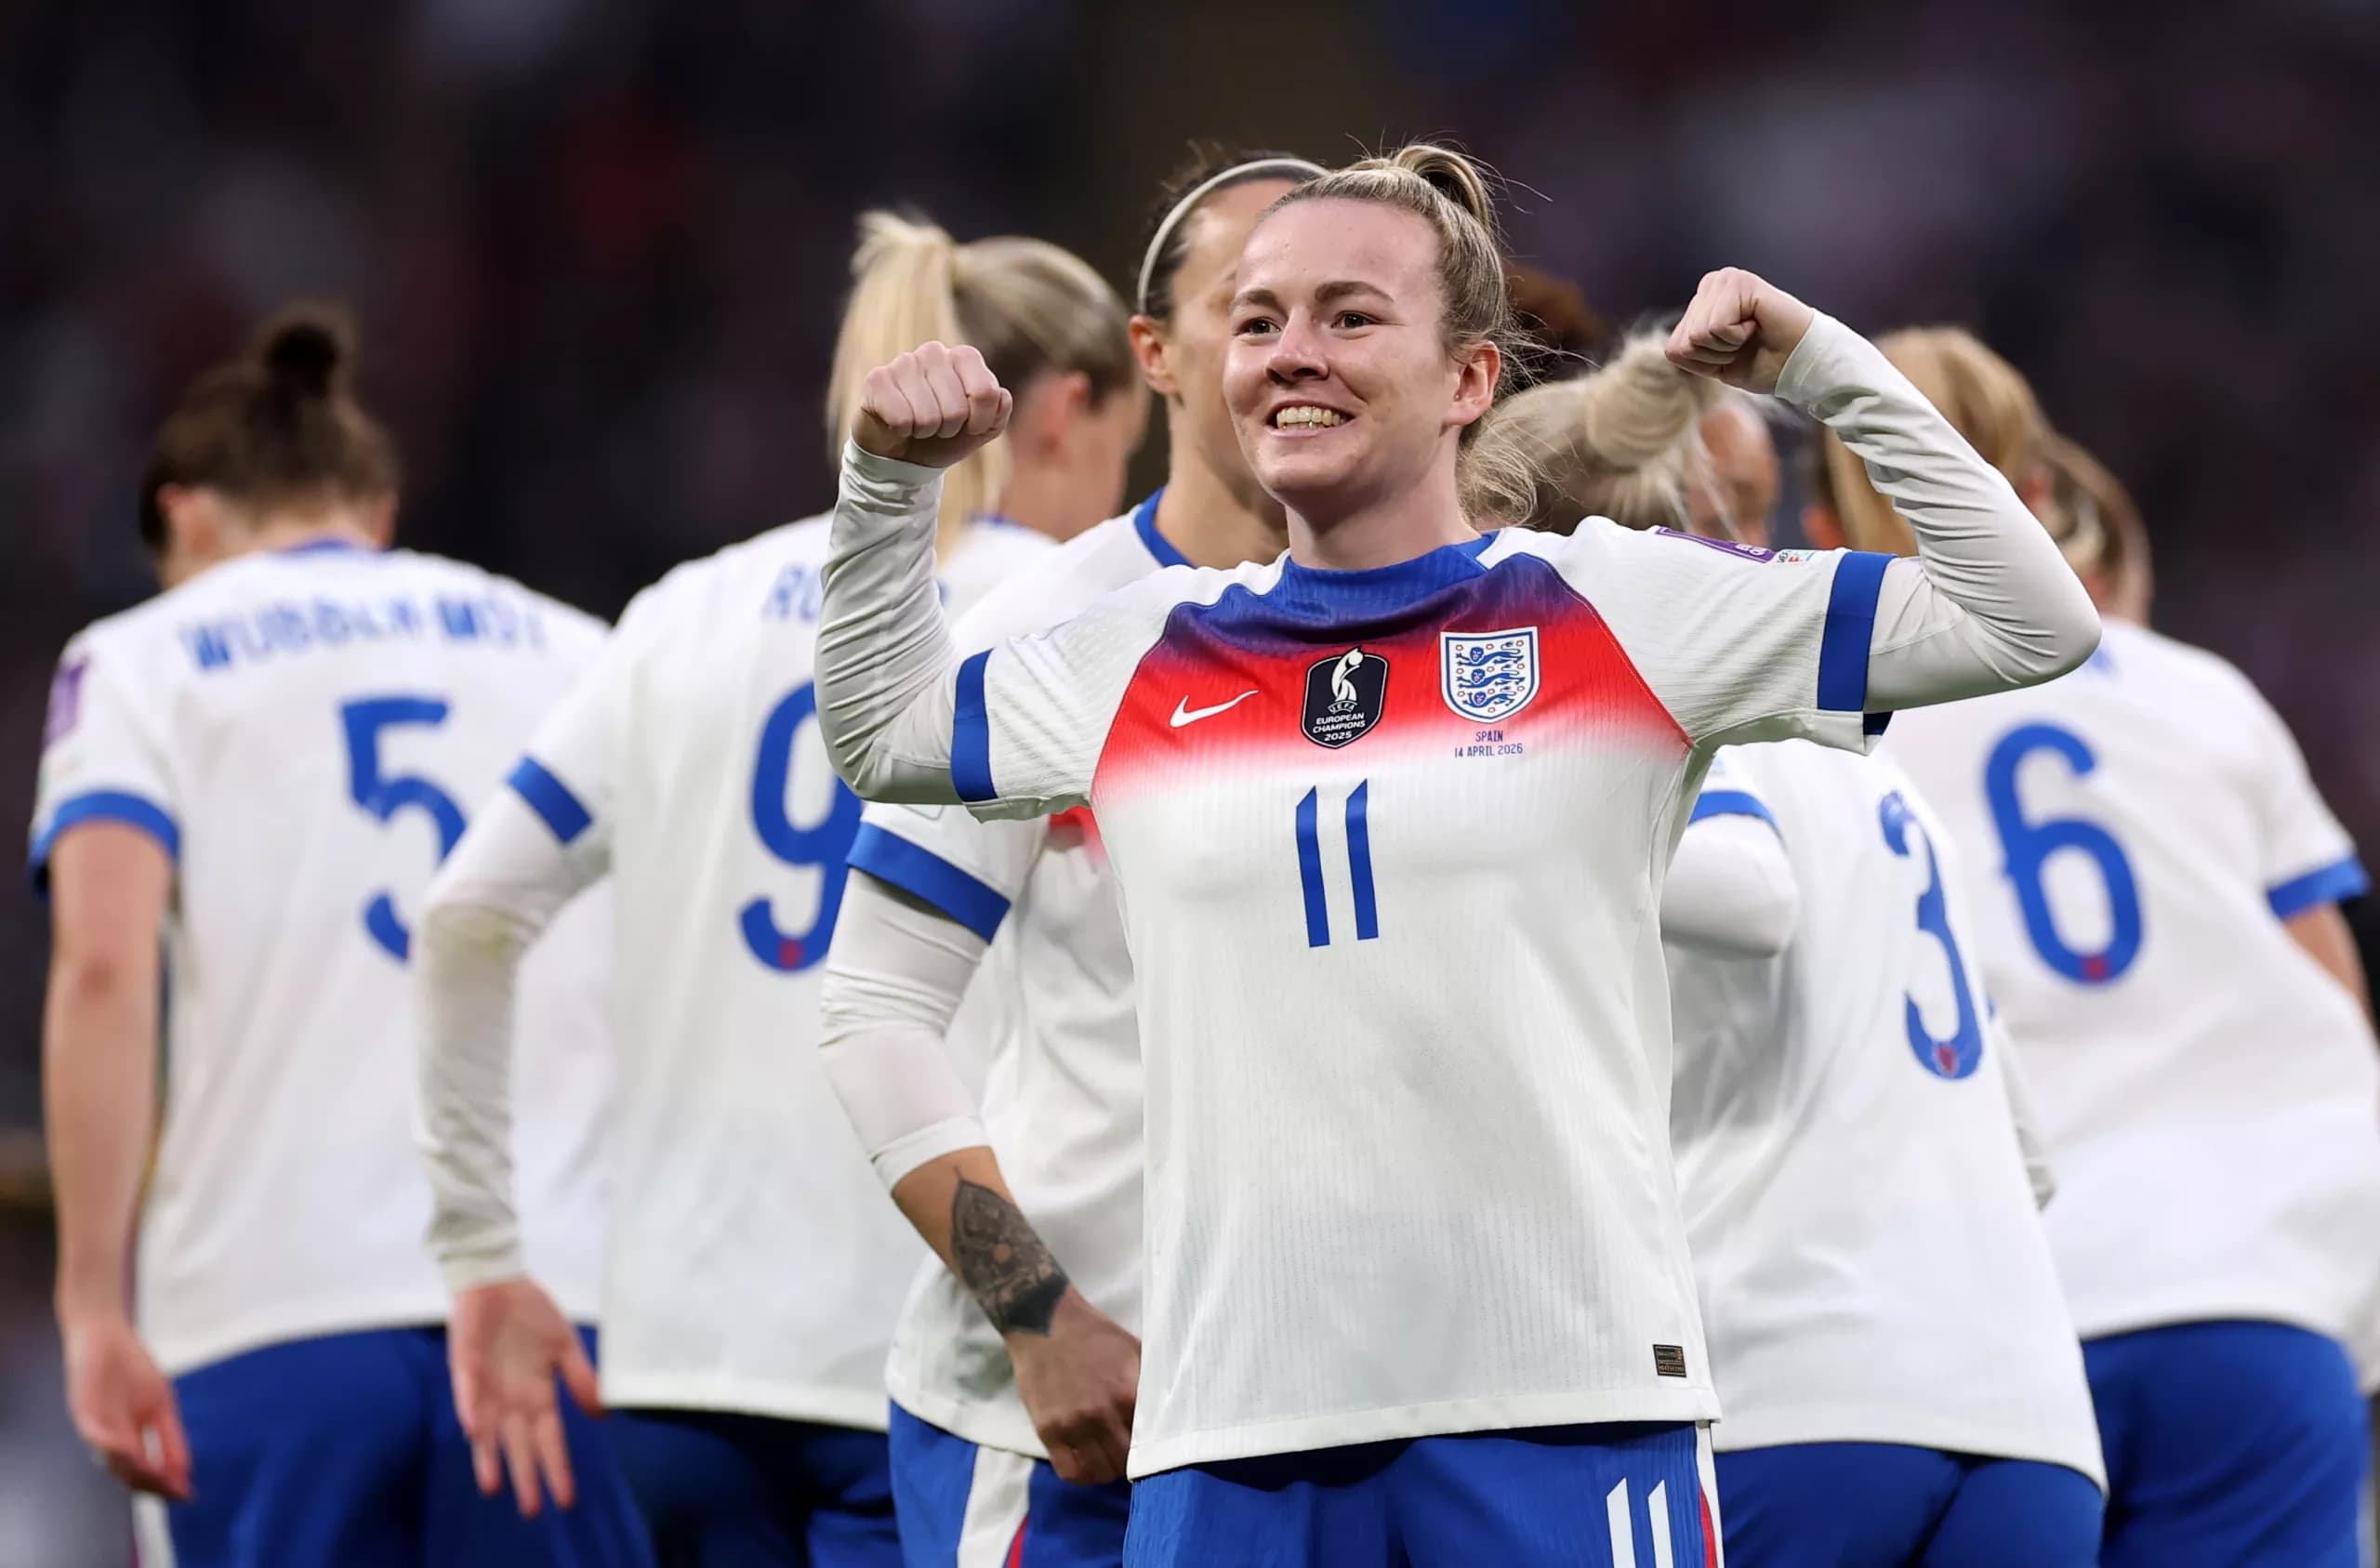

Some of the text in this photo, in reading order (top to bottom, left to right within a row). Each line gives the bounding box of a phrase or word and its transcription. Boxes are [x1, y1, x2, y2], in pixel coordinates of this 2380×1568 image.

[1329, 703, 1355, 714] UEFA
[1312, 719, 1366, 733] CHAMPIONS
[1316, 712, 1365, 725] EUROPEAN
[1324, 731, 1352, 742] 2025
[1475, 730, 1503, 743] SPAIN
[1455, 743, 1523, 758] 14 APRIL 2026
[338, 692, 469, 963] 5
[738, 679, 863, 972] 9
[1982, 719, 2145, 985] 6
[1295, 778, 1380, 948] 11
[1878, 788, 1983, 1081] 3
